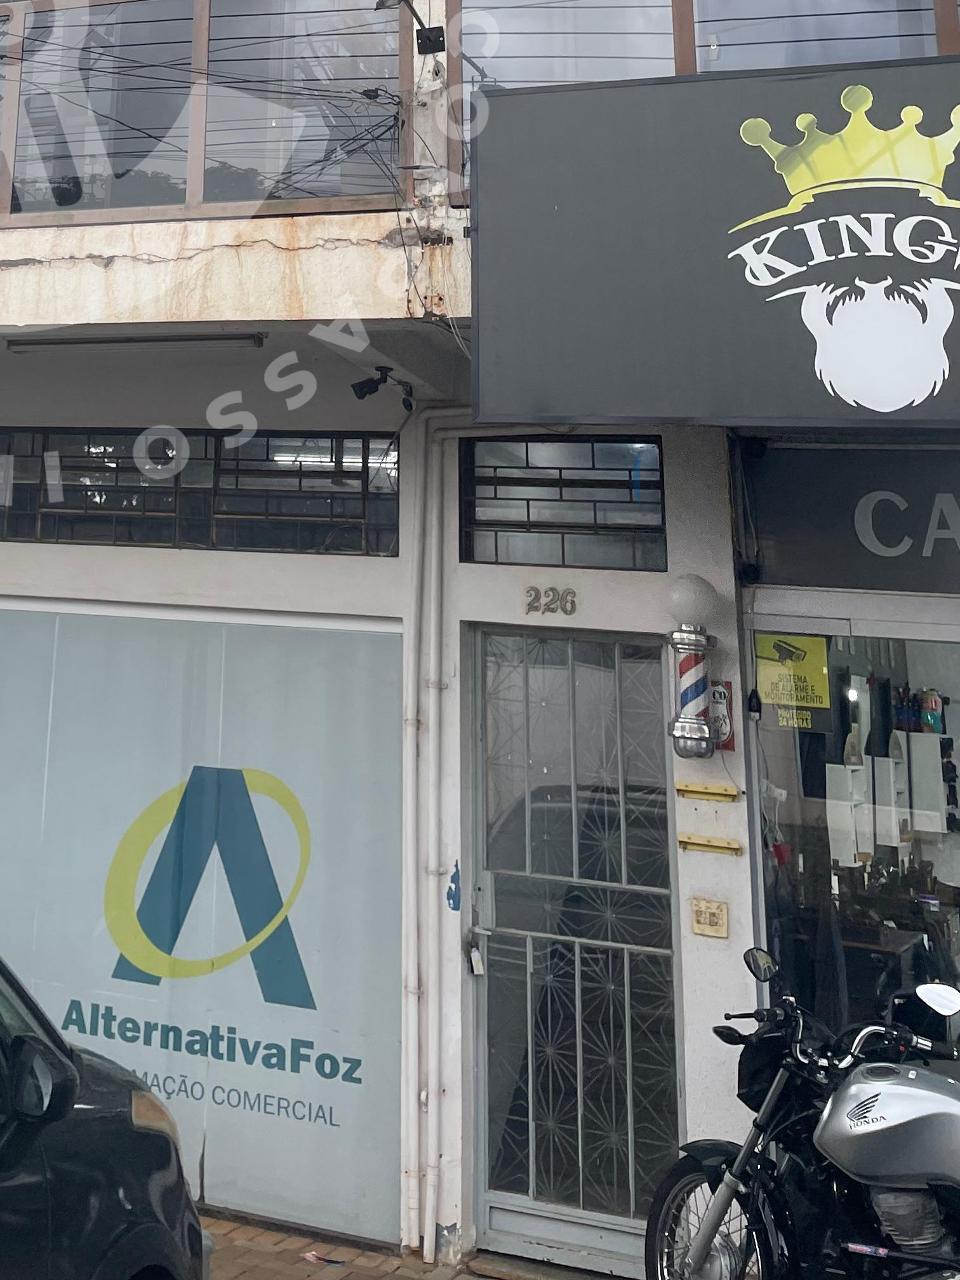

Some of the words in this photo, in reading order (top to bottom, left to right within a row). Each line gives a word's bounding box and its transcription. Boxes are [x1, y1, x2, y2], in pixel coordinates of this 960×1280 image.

[727, 212, 960, 287] KING
[525, 586, 576, 616] 226
[771, 683, 780, 691] DE
[781, 683, 809, 694] ALARME
[777, 673, 807, 684] SISTEMA
[764, 690, 824, 705] MONITORAMENTO
[60, 999, 363, 1085] AlternativaFoz
[211, 1085, 341, 1128] COMERCIAL
[849, 1115, 888, 1131] HONDA
